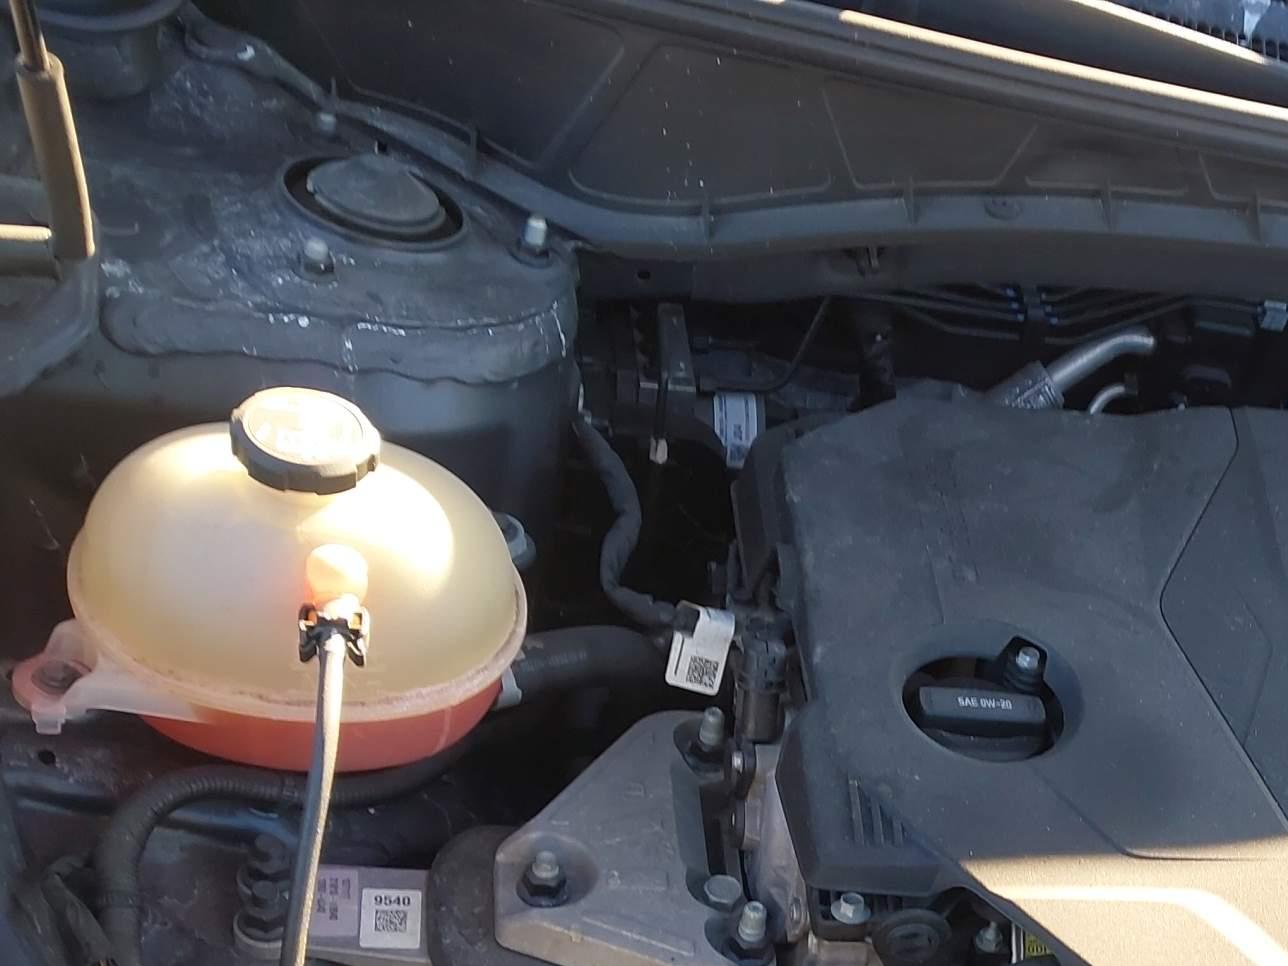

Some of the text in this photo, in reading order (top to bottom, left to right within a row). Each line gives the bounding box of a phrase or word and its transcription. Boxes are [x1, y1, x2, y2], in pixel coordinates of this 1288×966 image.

[958, 696, 1013, 710] SAE 0W-20
[374, 895, 411, 907] 9540
